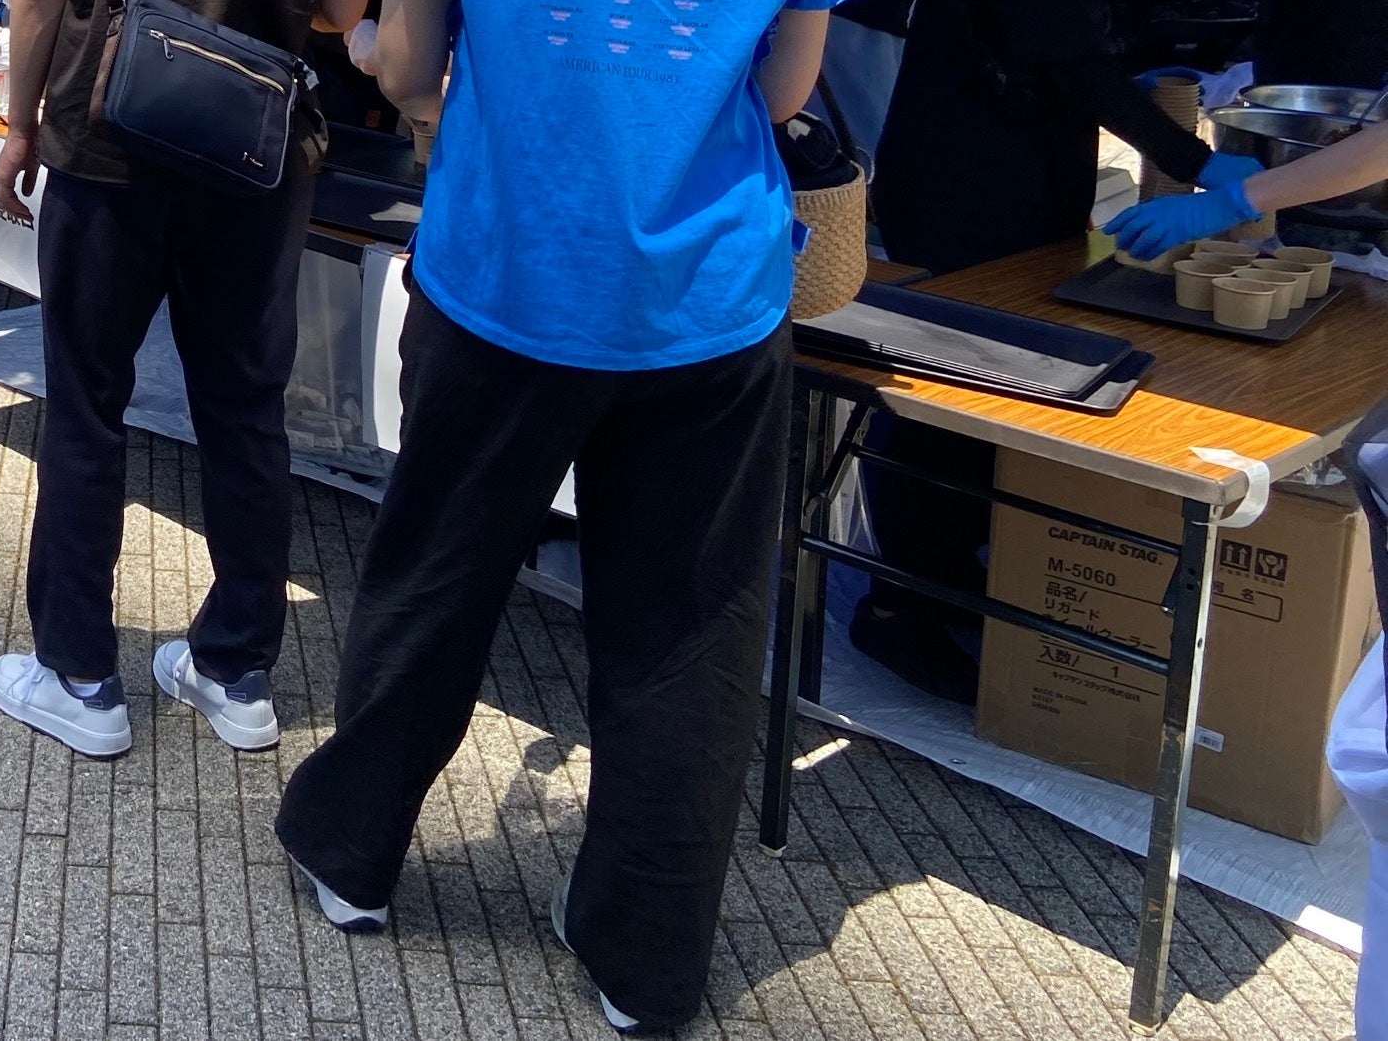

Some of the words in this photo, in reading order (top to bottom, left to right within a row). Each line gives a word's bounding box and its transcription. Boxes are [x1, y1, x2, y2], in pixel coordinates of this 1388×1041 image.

[561, 59, 622, 76] AMERICAN
[1048, 526, 1115, 553] CAPTAIN
[1047, 556, 1117, 588] M-5060
[1044, 597, 1100, 621] リガード
